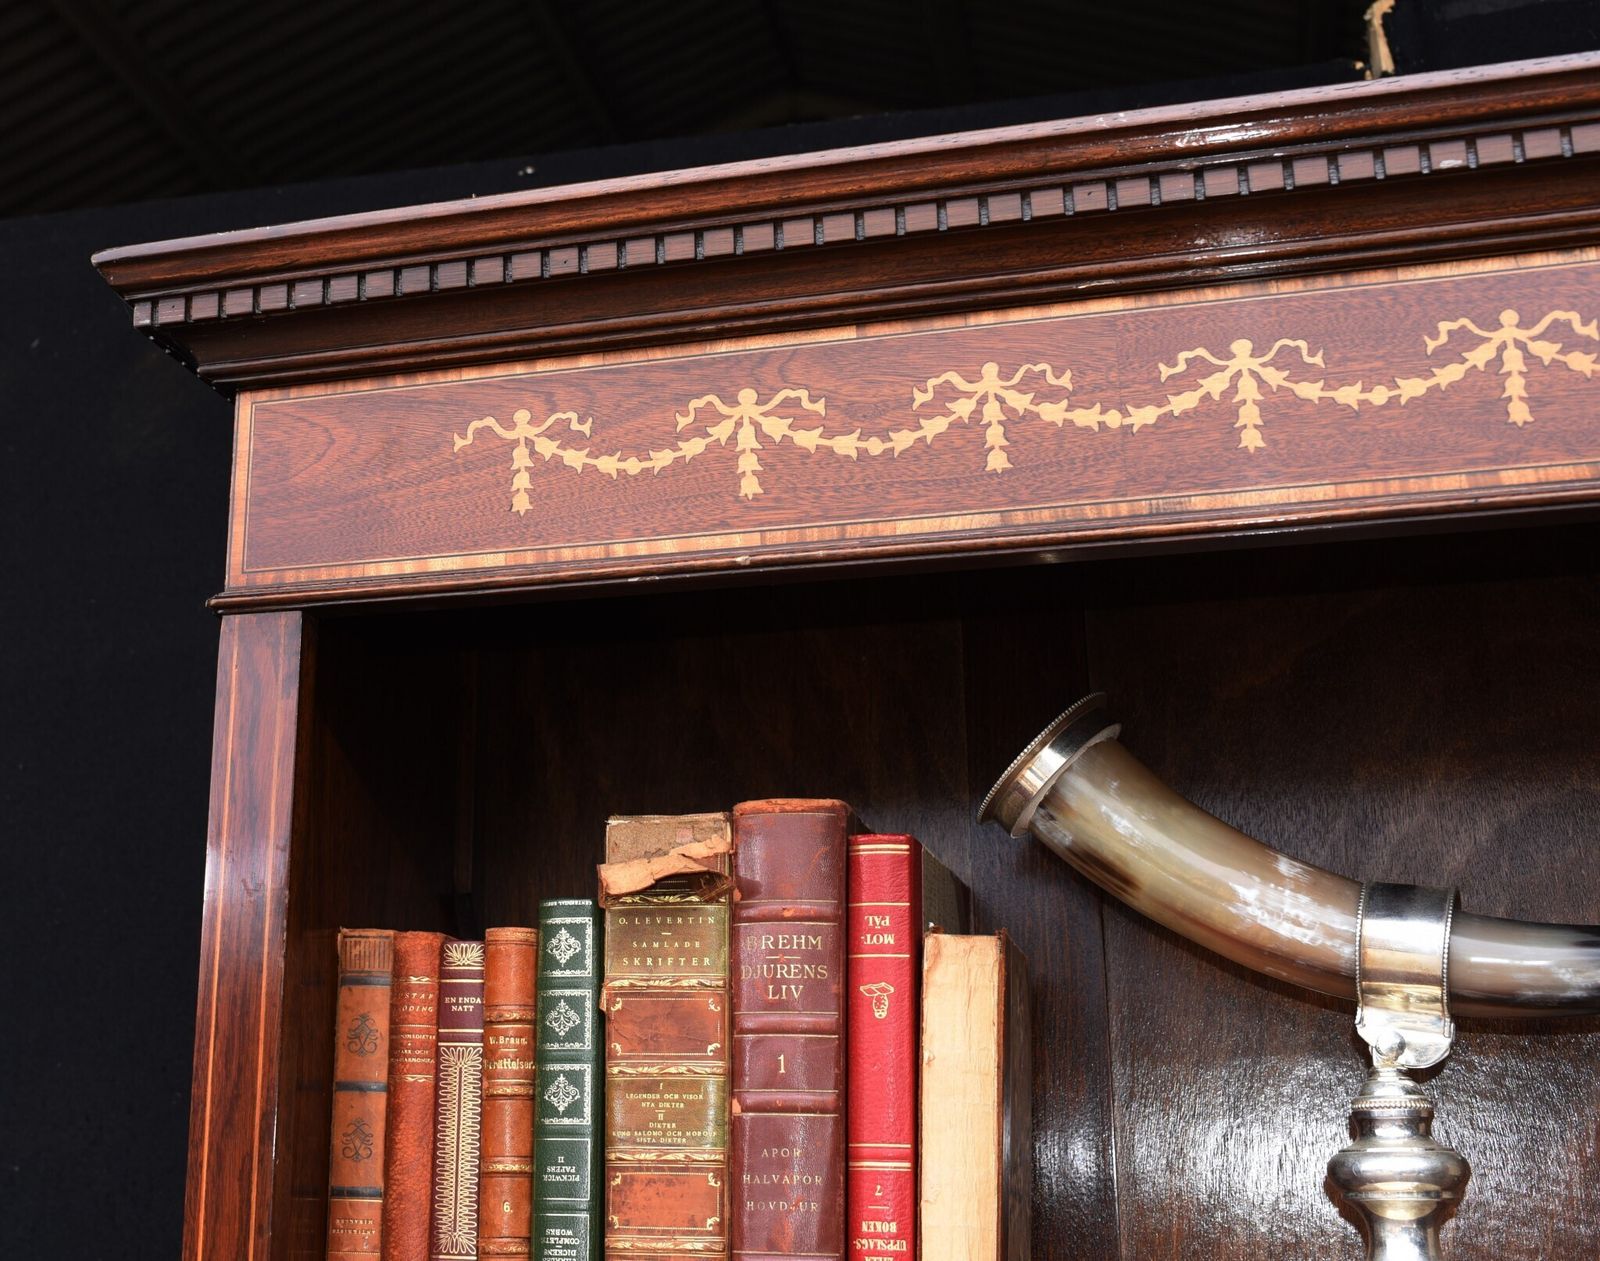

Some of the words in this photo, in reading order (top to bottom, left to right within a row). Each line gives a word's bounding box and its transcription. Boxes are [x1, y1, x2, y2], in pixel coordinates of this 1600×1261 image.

[618, 917, 629, 925] O.
[635, 916, 716, 925] LEVERTIN
[864, 915, 890, 929] PÄL
[632, 940, 701, 948] SAMLADE
[747, 934, 822, 950] BREHM
[622, 957, 711, 967] SKRIFTER
[740, 963, 828, 980] DJURENS
[768, 984, 804, 1000] LIV
[458, 996, 482, 1005] ENDA
[777, 1054, 786, 1074] 1
[625, 1092, 660, 1100] LEGENDER
[648, 1121, 677, 1129] DIKTER
[761, 1147, 803, 1158] APOR
[546, 1165, 576, 1173] PAPERS
[742, 1173, 823, 1186] HALVAPOR
[861, 1220, 898, 1234] BOKEN
[545, 1228, 573, 1237] WORKS
